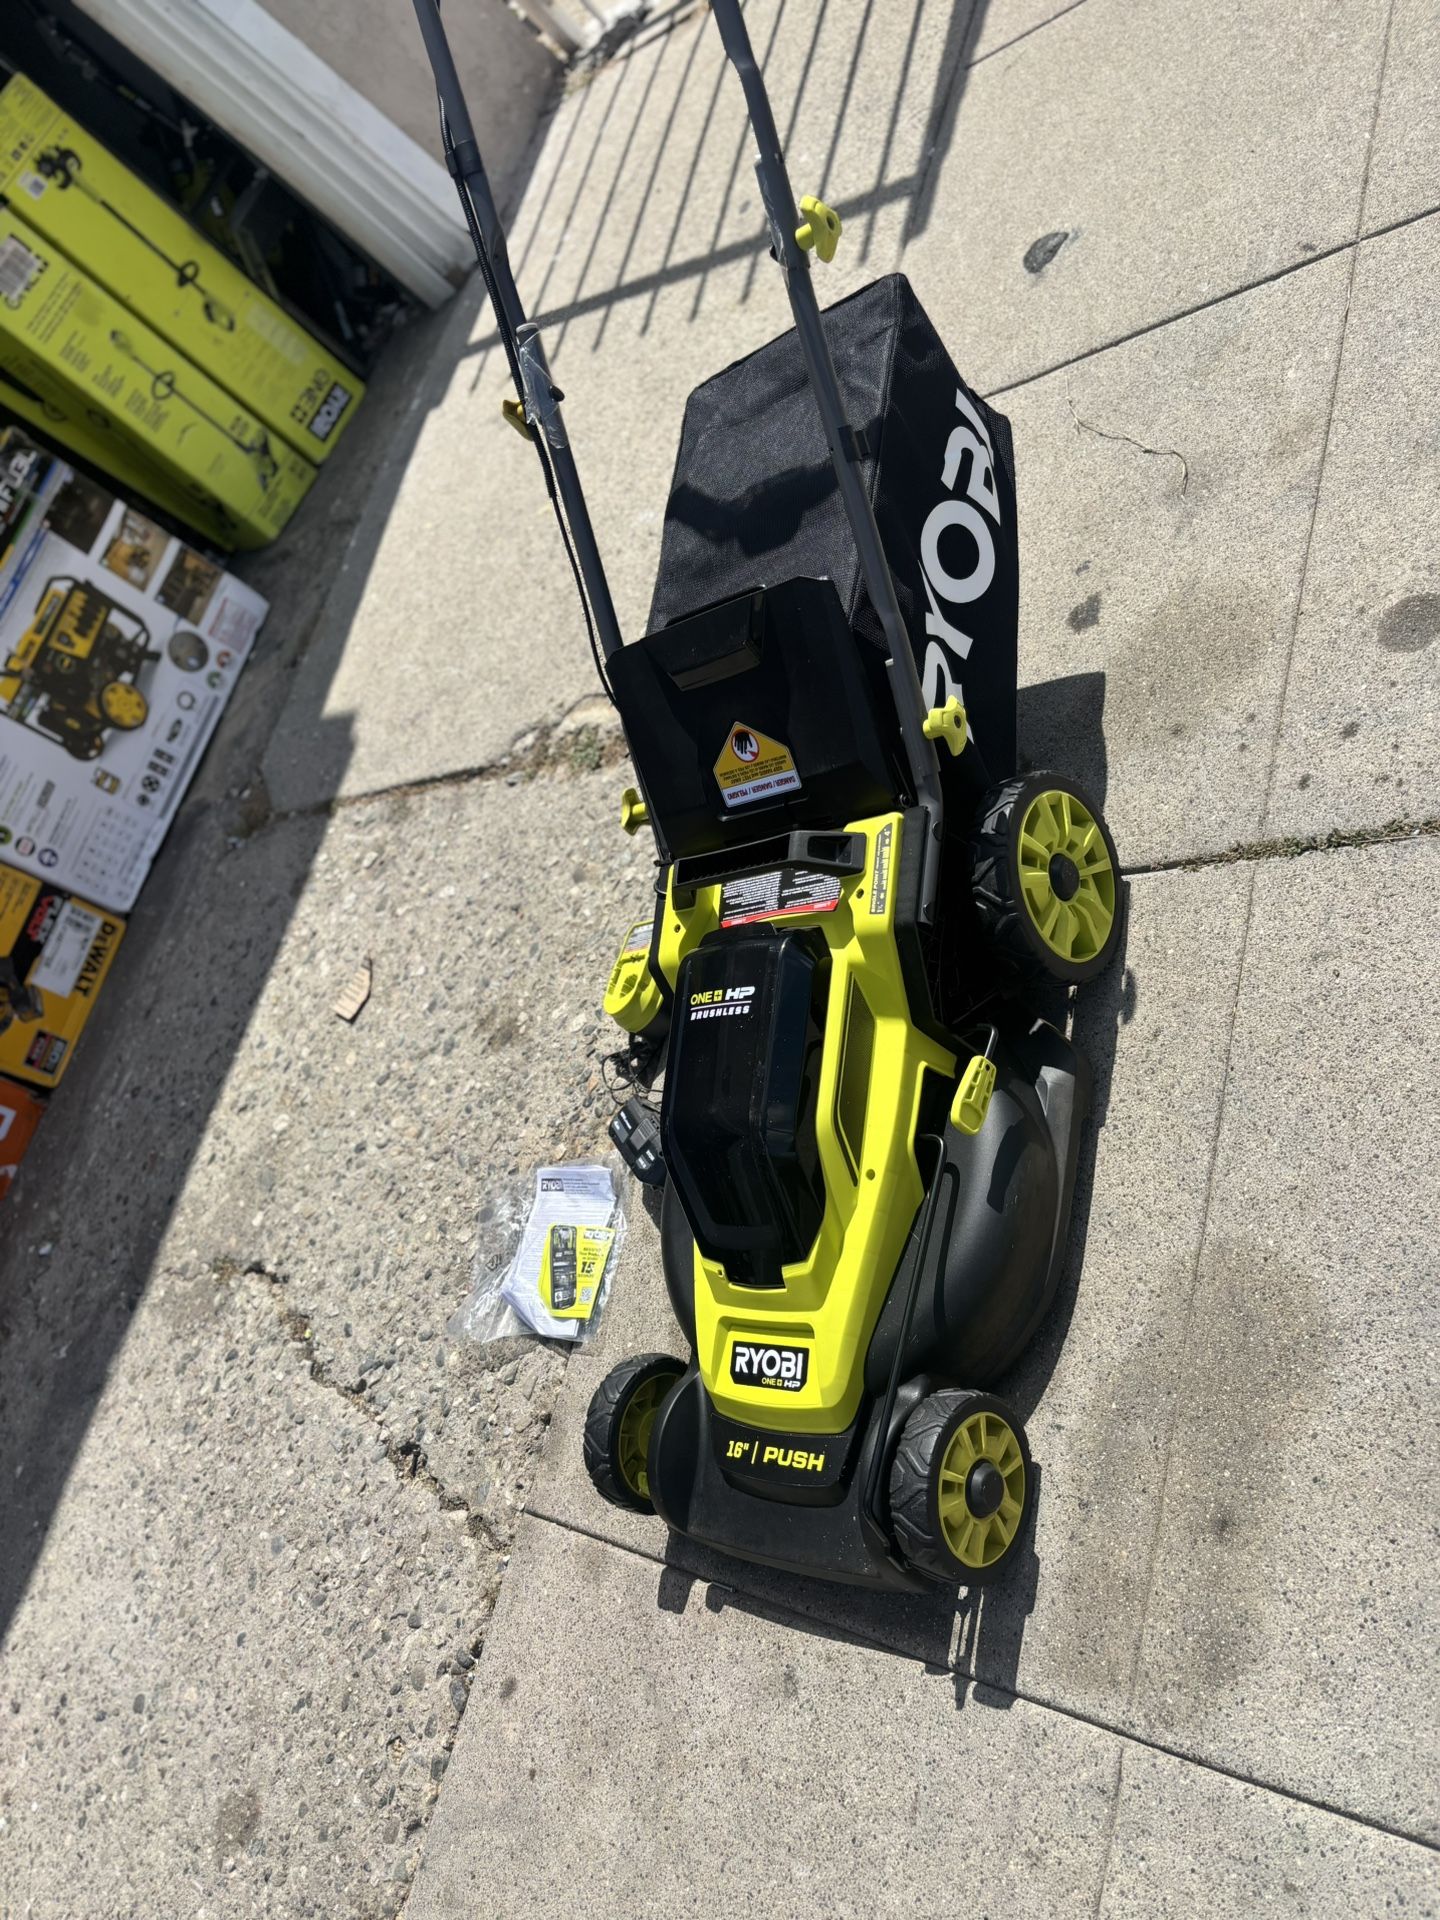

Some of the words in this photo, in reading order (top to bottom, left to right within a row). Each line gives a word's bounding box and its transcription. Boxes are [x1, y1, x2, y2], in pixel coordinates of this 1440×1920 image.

[917, 388, 1000, 745] RYOBI
[725, 986, 756, 1000] HP
[690, 1005, 750, 1021] BRUSHLESS
[735, 1346, 803, 1380] RYOBI
[784, 1379, 800, 1388] HP
[726, 1440, 750, 1458] 16"
[762, 1446, 825, 1472] PUSH
